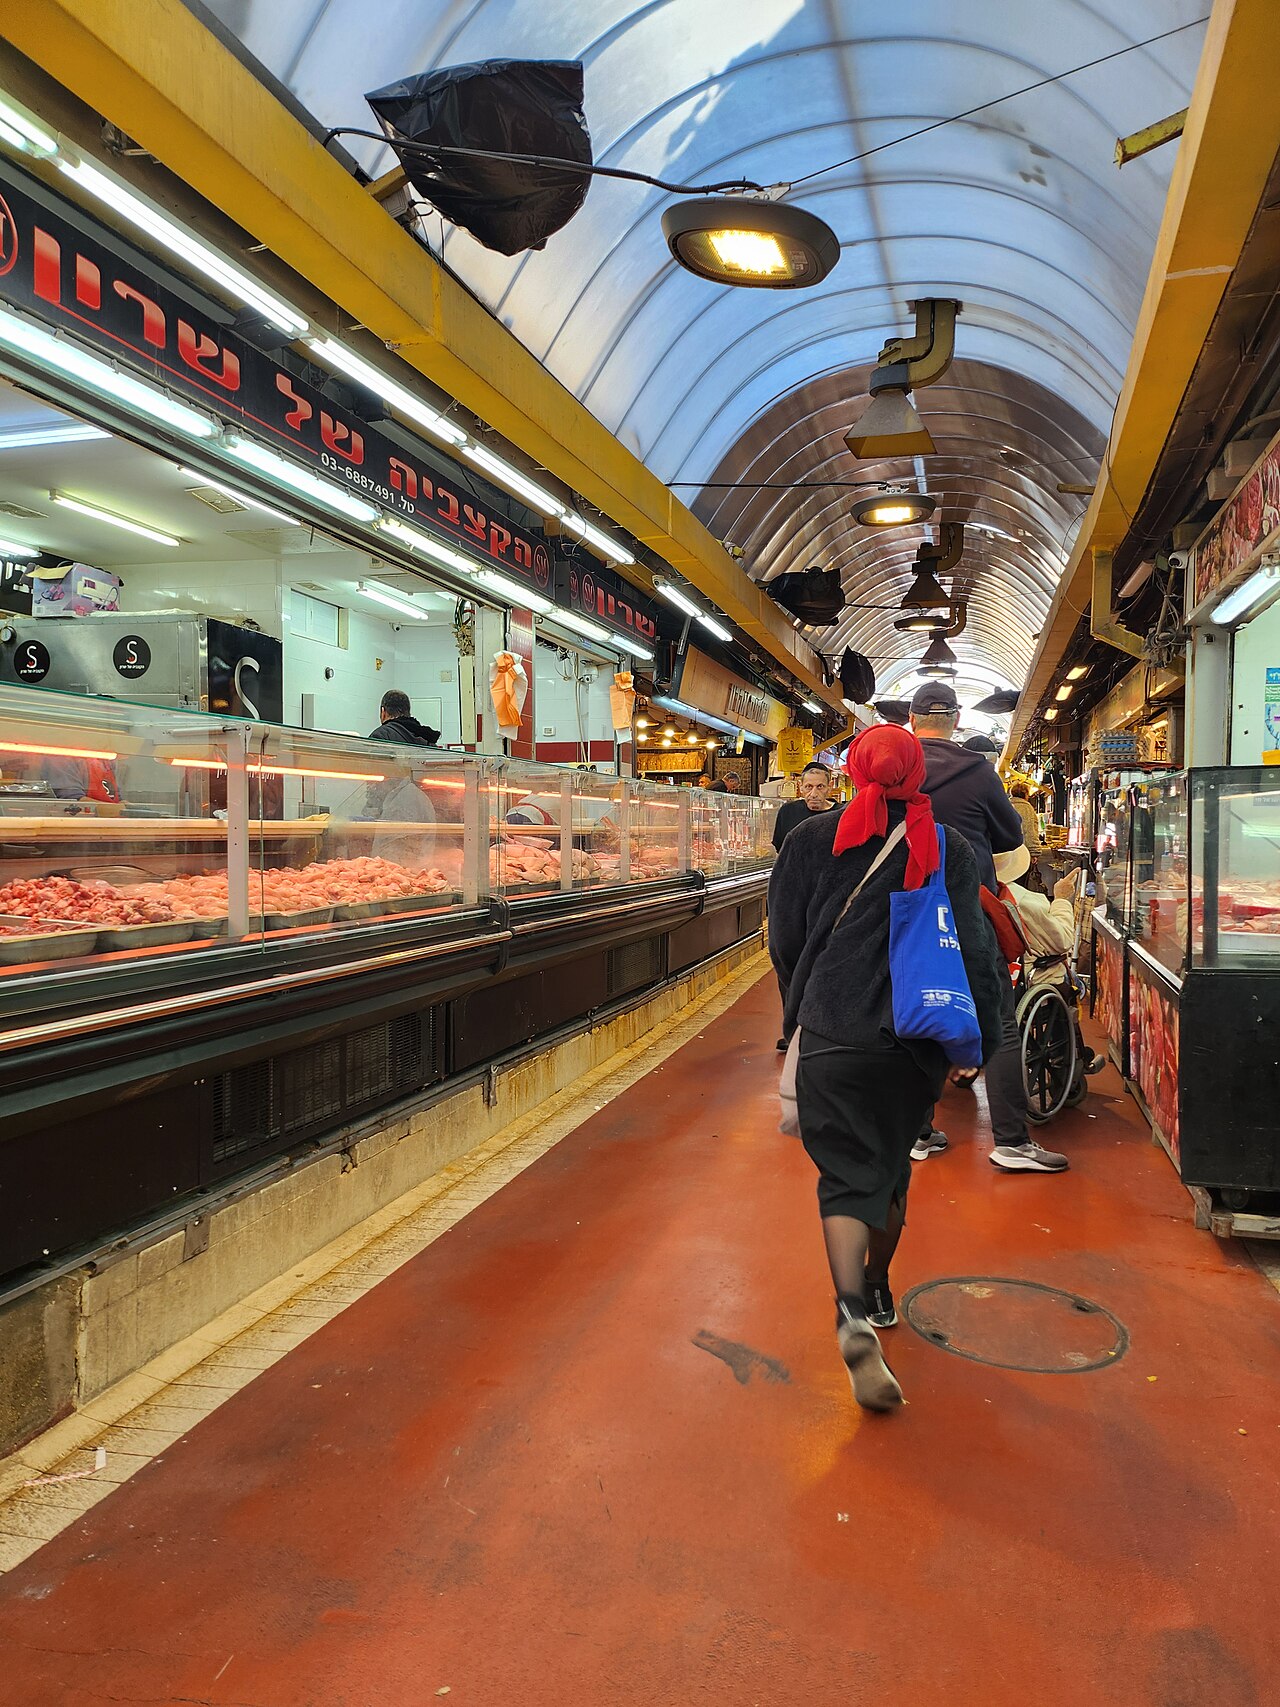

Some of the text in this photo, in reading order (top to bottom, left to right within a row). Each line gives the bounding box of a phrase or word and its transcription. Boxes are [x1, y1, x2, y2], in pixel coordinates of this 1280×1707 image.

[276, 373, 364, 465] של
[321, 452, 415, 514] טל. 03-6887491
[389, 456, 532, 568] הקצביה
